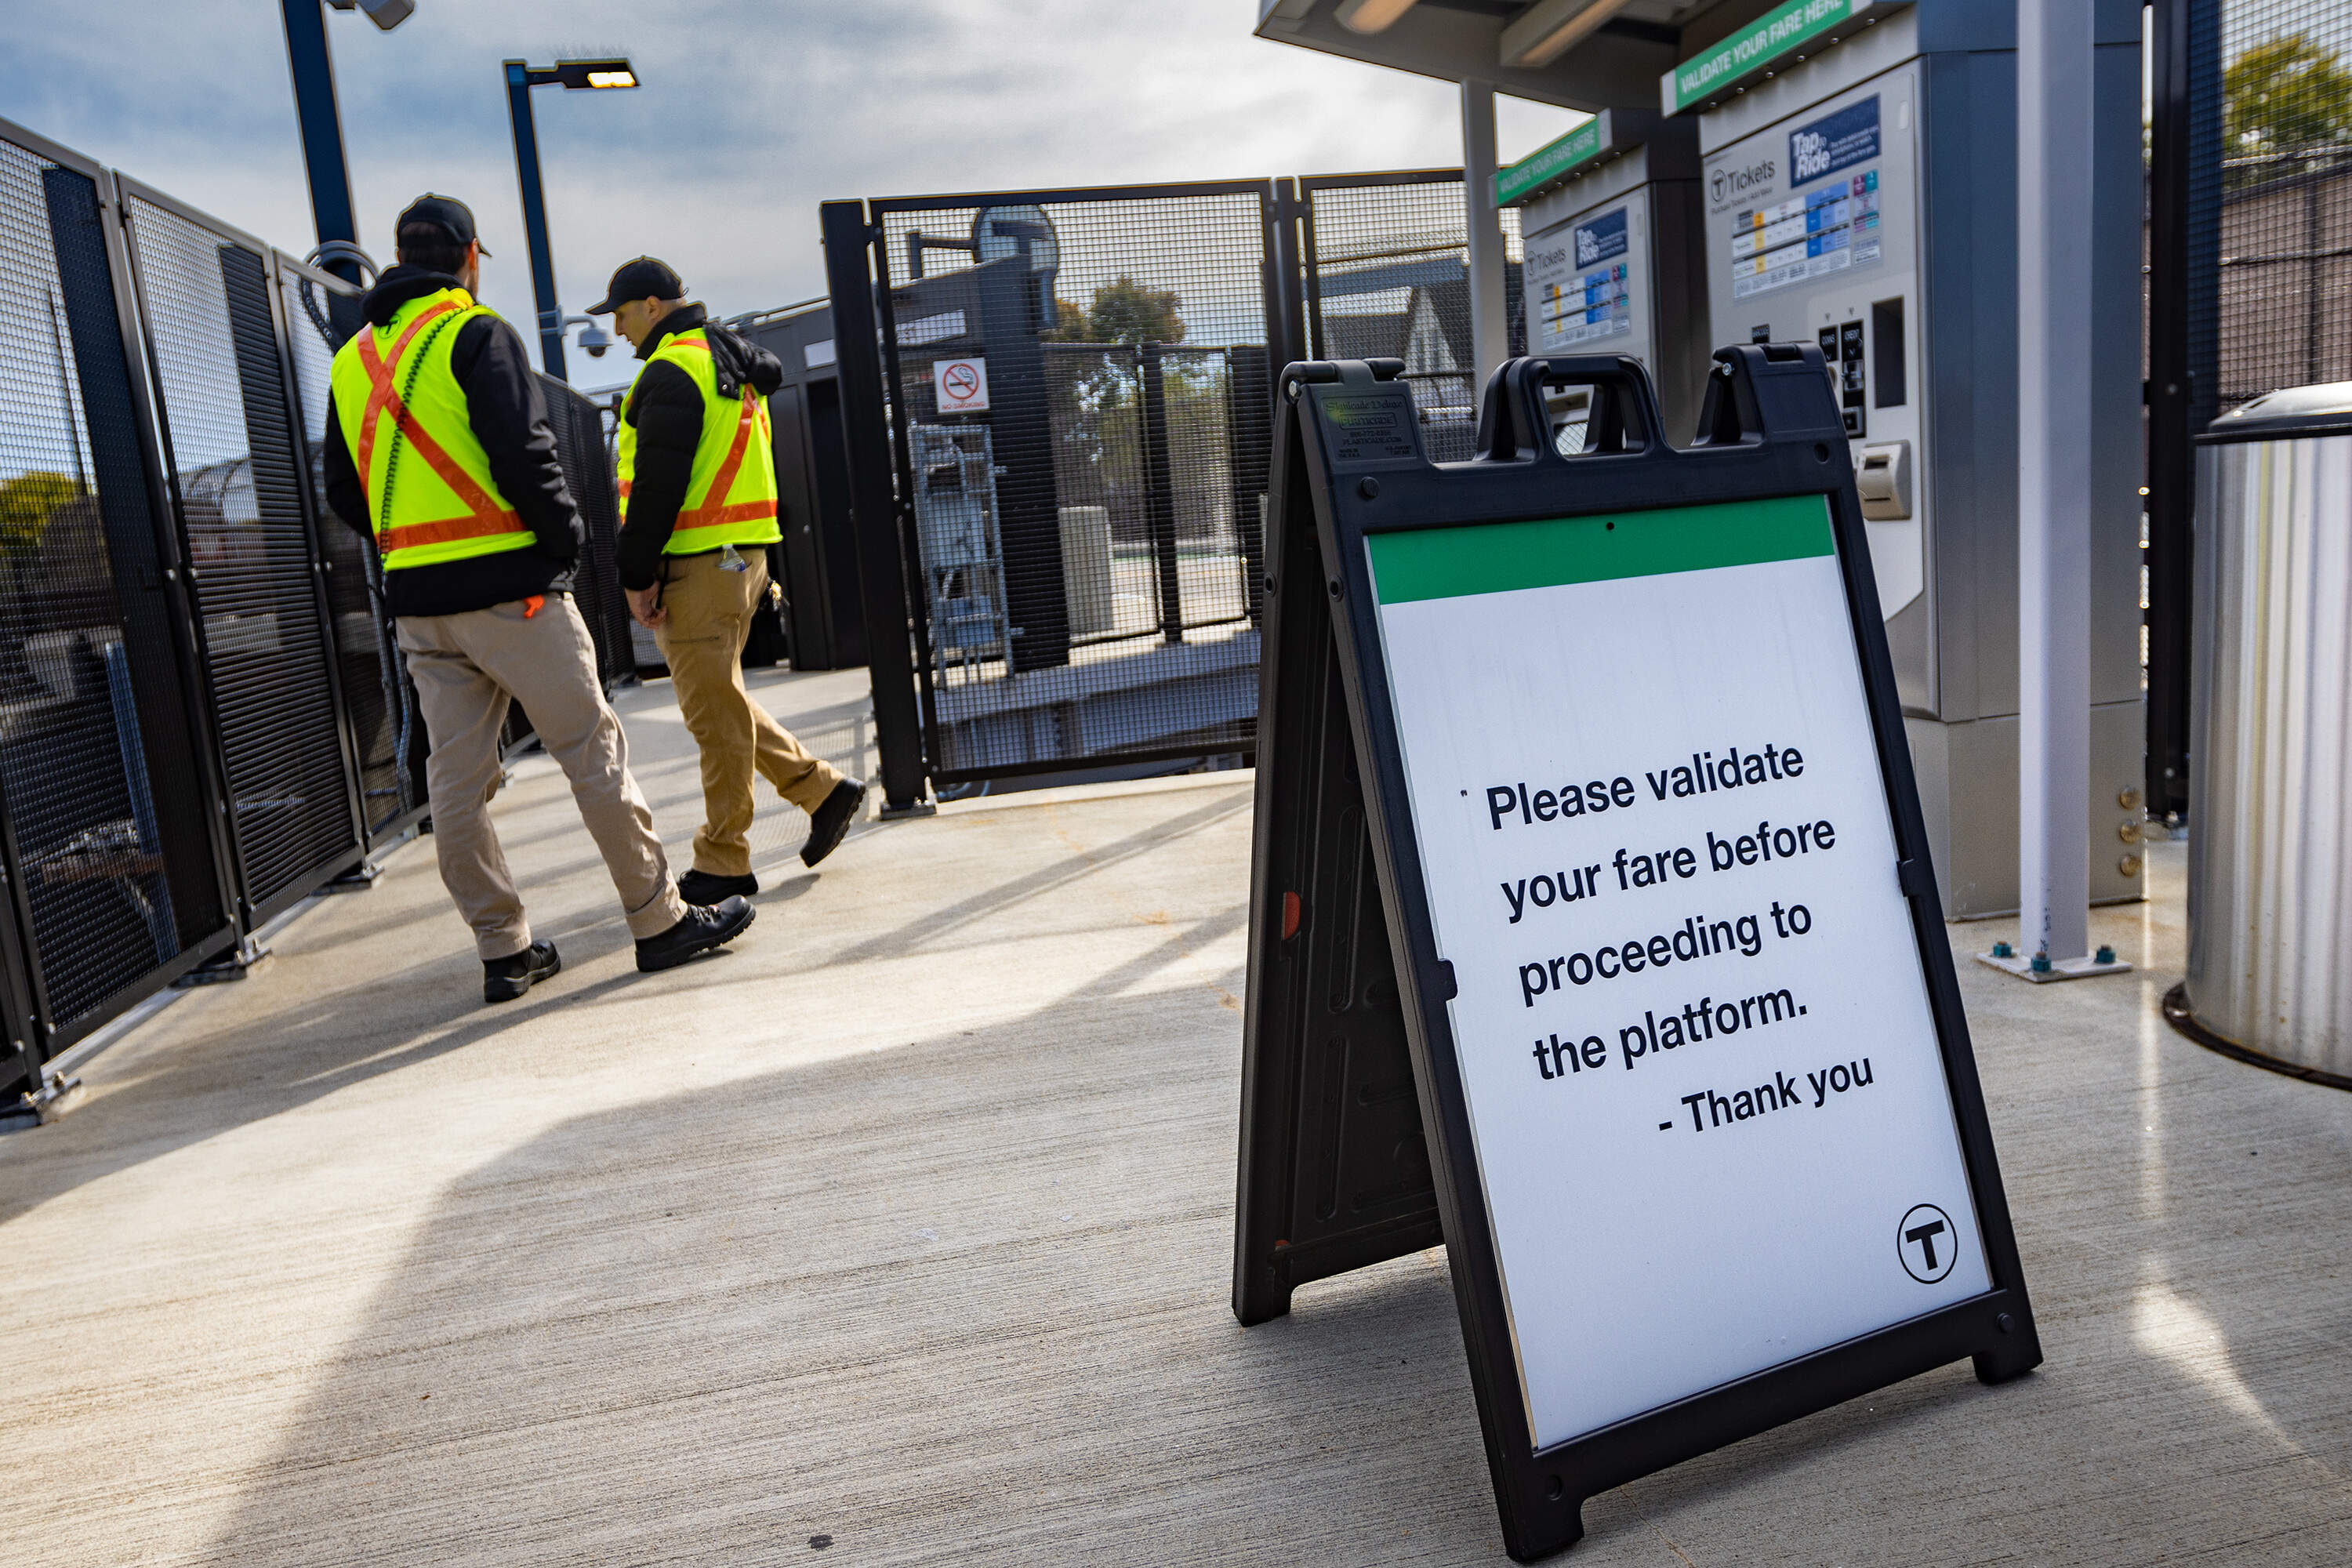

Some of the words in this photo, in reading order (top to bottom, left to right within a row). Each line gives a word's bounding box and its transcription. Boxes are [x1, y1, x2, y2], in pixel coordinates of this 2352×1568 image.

[1681, 50, 1732, 94] VALIDATE
[1731, 30, 1768, 64] YOUR
[1769, 9, 1802, 45] FARE
[1500, 169, 1531, 193] VALIDATE
[1530, 152, 1552, 175] YOUR
[1573, 128, 1595, 153] HERE
[1792, 132, 1820, 157] Tap
[1794, 150, 1831, 182] Ride
[1728, 159, 1775, 194] Tickets
[1537, 247, 1566, 270] Tickets
[1821, 333, 1835, 346] COINS
[953, 401, 985, 409] SMOKING
[1372, 398, 1403, 409] Deluxe
[1486, 776, 1635, 830] Please
[1645, 743, 1804, 801] validate
[1500, 863, 1602, 924] your
[1612, 847, 1697, 891] fare
[1706, 820, 1835, 873] before
[1519, 915, 1762, 1008] proceeding
[1769, 901, 1812, 938] to
[1532, 1033, 1607, 1080] the
[1619, 988, 1808, 1071] platform.
[1658, 1120, 1673, 1131] -
[1680, 1071, 1802, 1133] Thank
[1806, 1058, 1874, 1109] you
